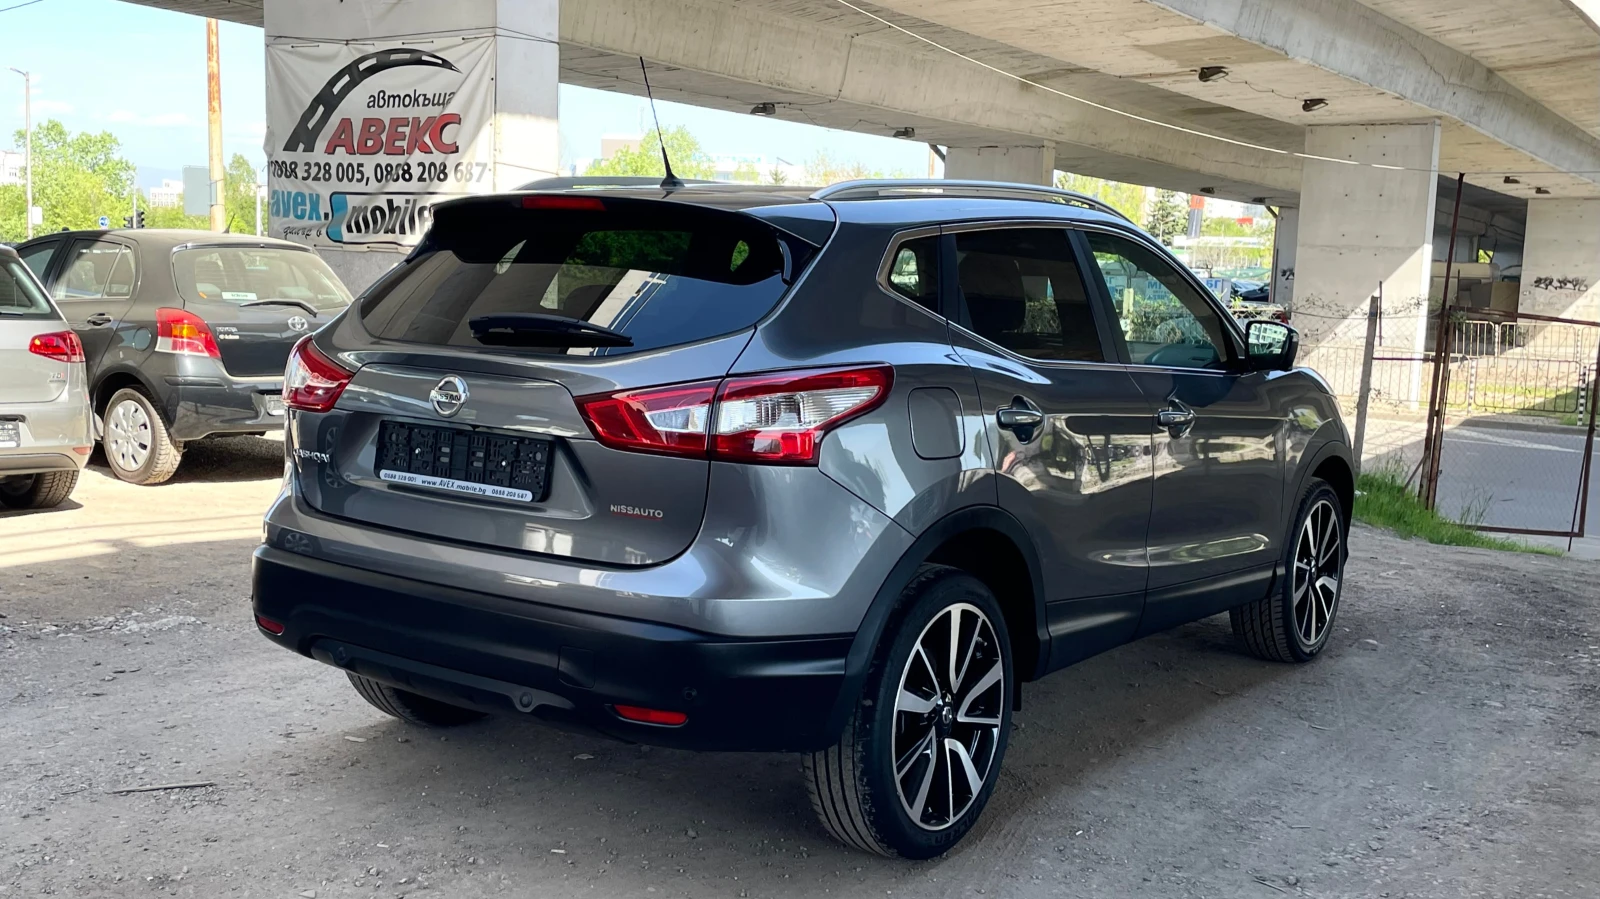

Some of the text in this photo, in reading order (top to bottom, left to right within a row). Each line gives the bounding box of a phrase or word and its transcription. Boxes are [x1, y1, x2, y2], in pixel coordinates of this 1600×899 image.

[324, 113, 462, 155] АВЕКС
[301, 162, 332, 182] 328
[336, 162, 370, 186] 005,
[374, 162, 413, 183] 0888
[417, 162, 448, 182] 208
[454, 162, 487, 183] 687
[610, 504, 663, 518] NISSAUTO
